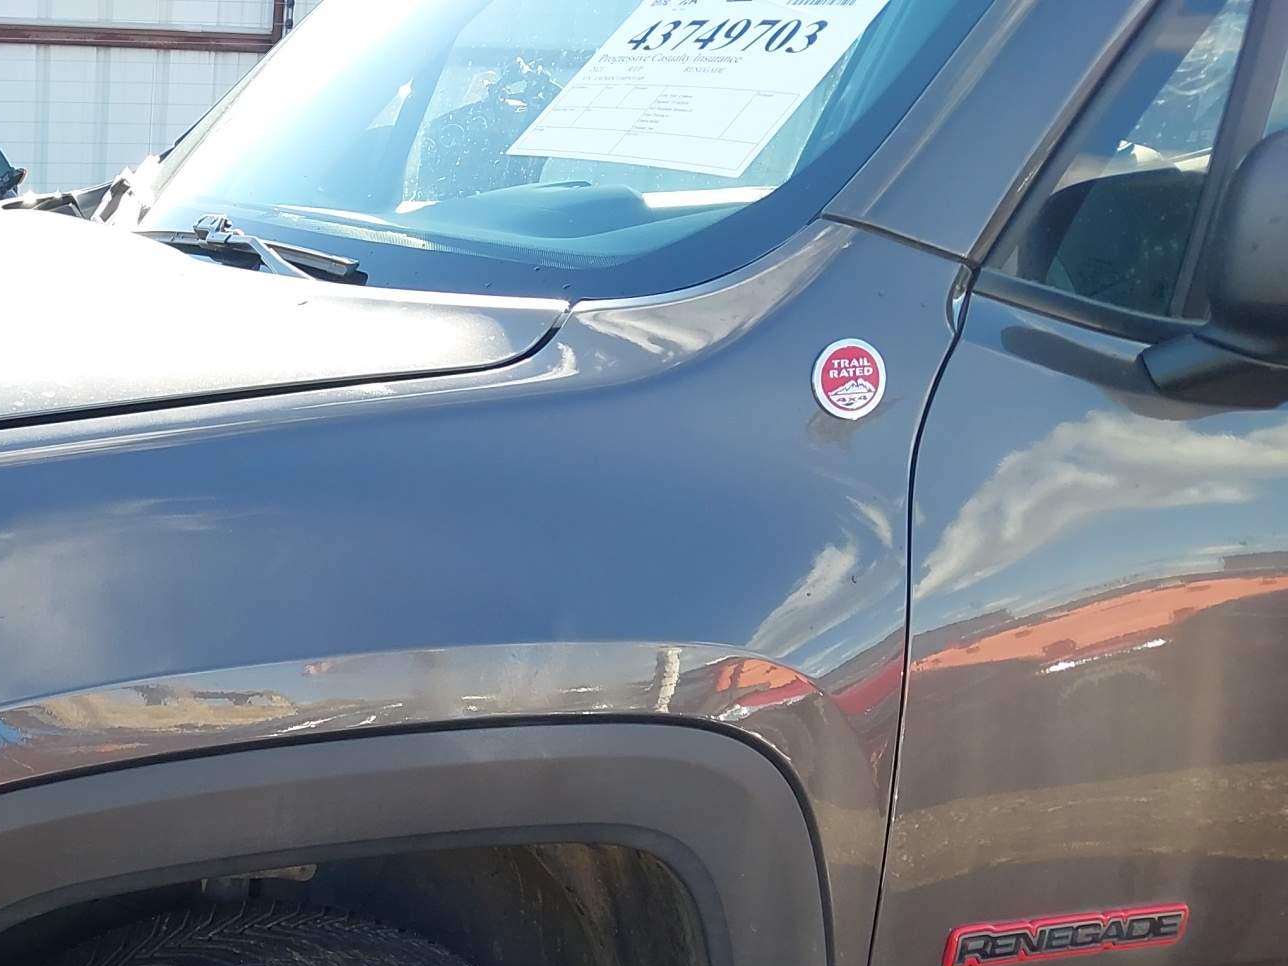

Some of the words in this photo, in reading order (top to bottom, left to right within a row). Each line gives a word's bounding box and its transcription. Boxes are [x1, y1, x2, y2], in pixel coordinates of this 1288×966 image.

[627, 18, 829, 54] 43749703
[829, 366, 873, 379] RATED
[832, 357, 871, 368] TRAIL
[954, 912, 1185, 966] RENEGADE
